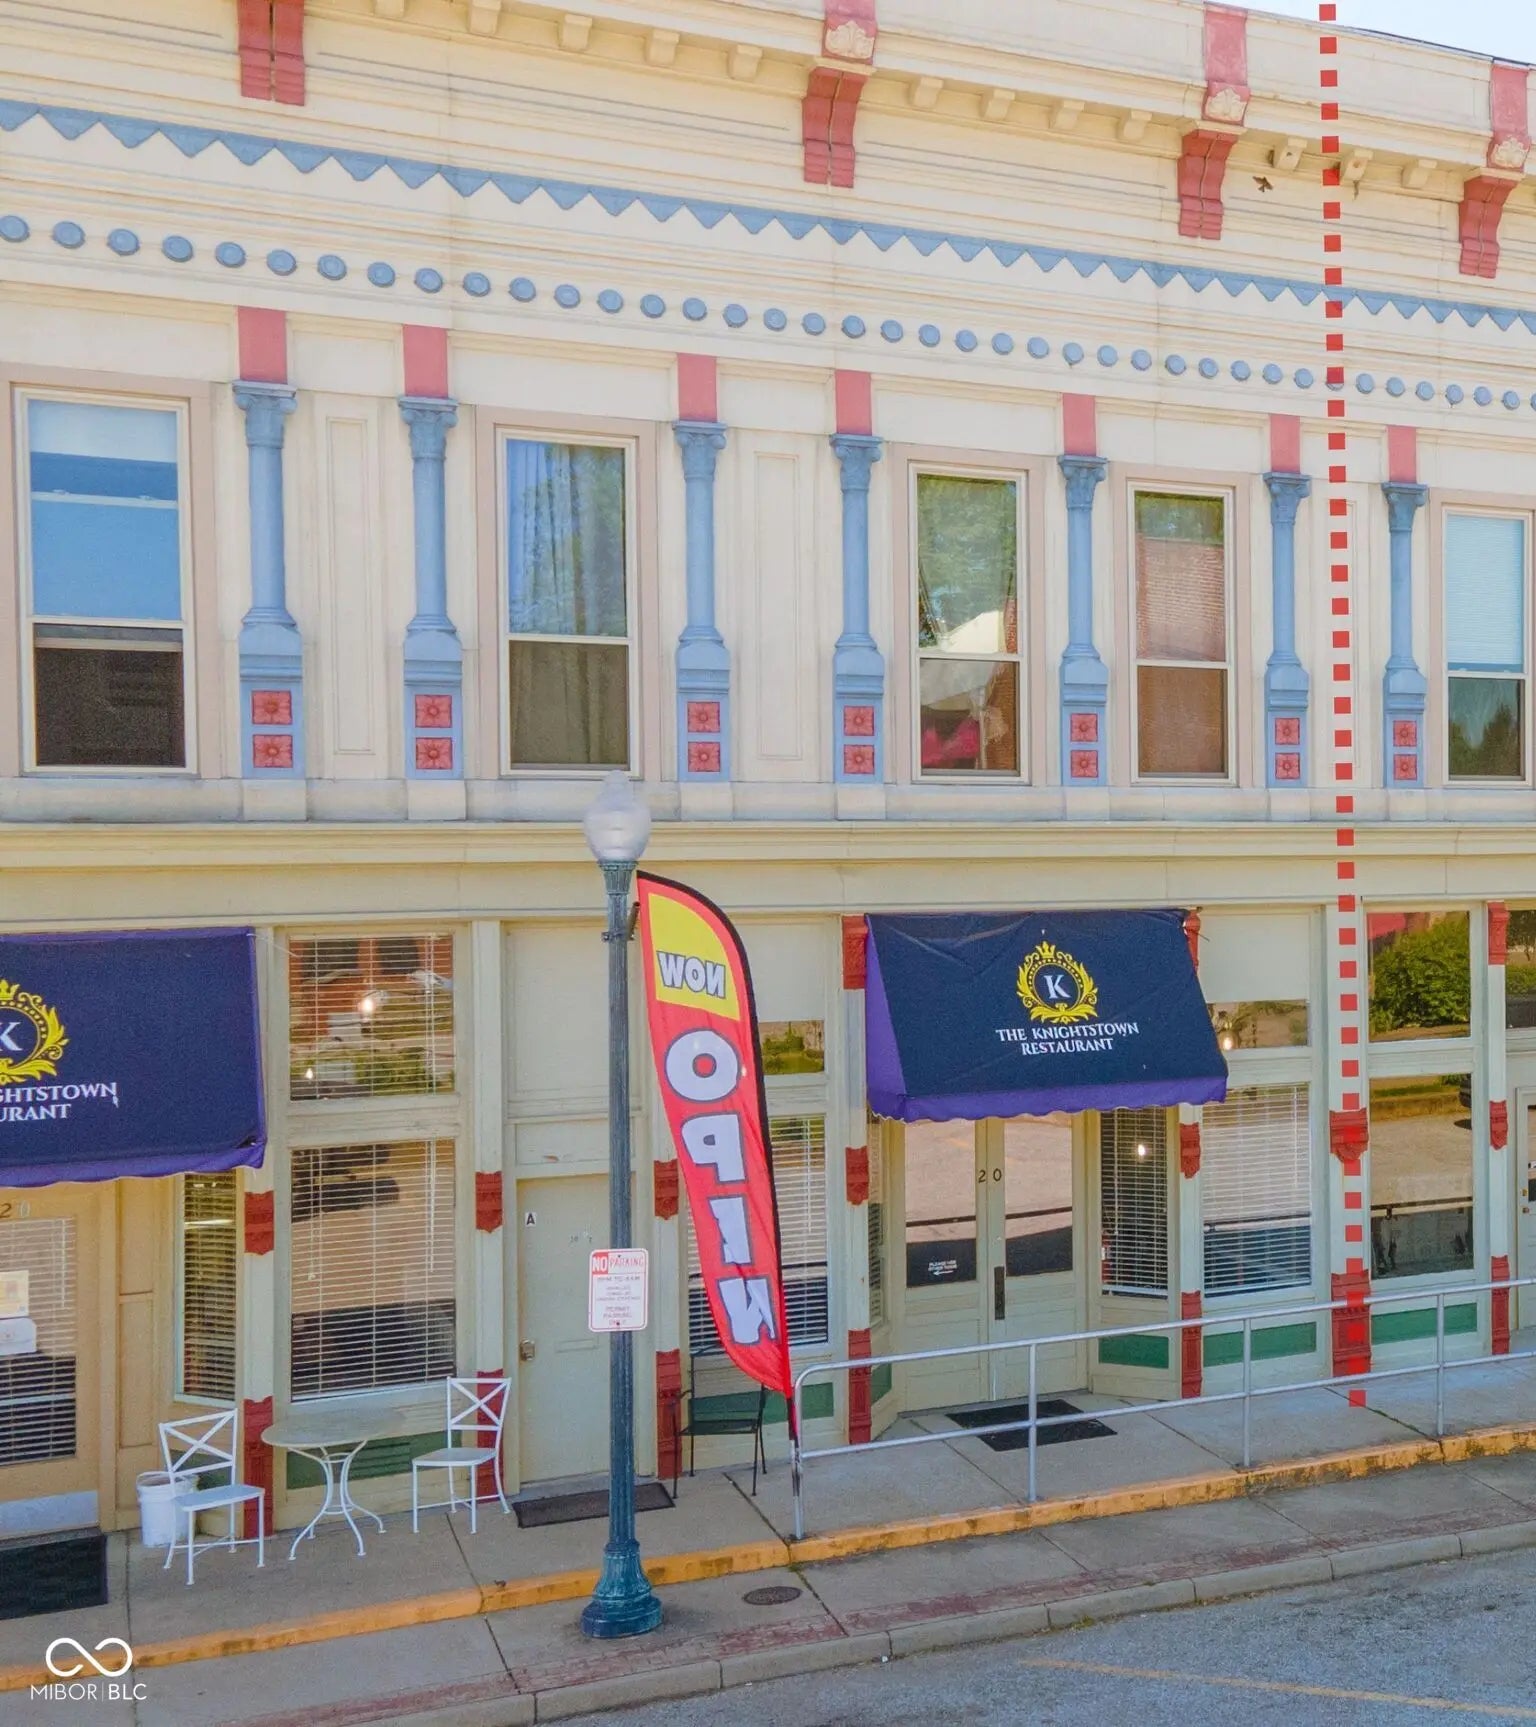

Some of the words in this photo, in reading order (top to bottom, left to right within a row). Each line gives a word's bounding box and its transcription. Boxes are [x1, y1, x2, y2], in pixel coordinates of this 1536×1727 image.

[1043, 974, 1071, 999] K
[995, 1028, 1027, 1042] THE
[1032, 1022, 1140, 1040] KNIGHTSTOWN
[1021, 1038, 1113, 1056] RESTAURANT
[978, 1168, 1002, 1183] 20
[526, 1213, 535, 1226] A
[592, 1256, 608, 1272] NO
[609, 1257, 644, 1268] PARKING
